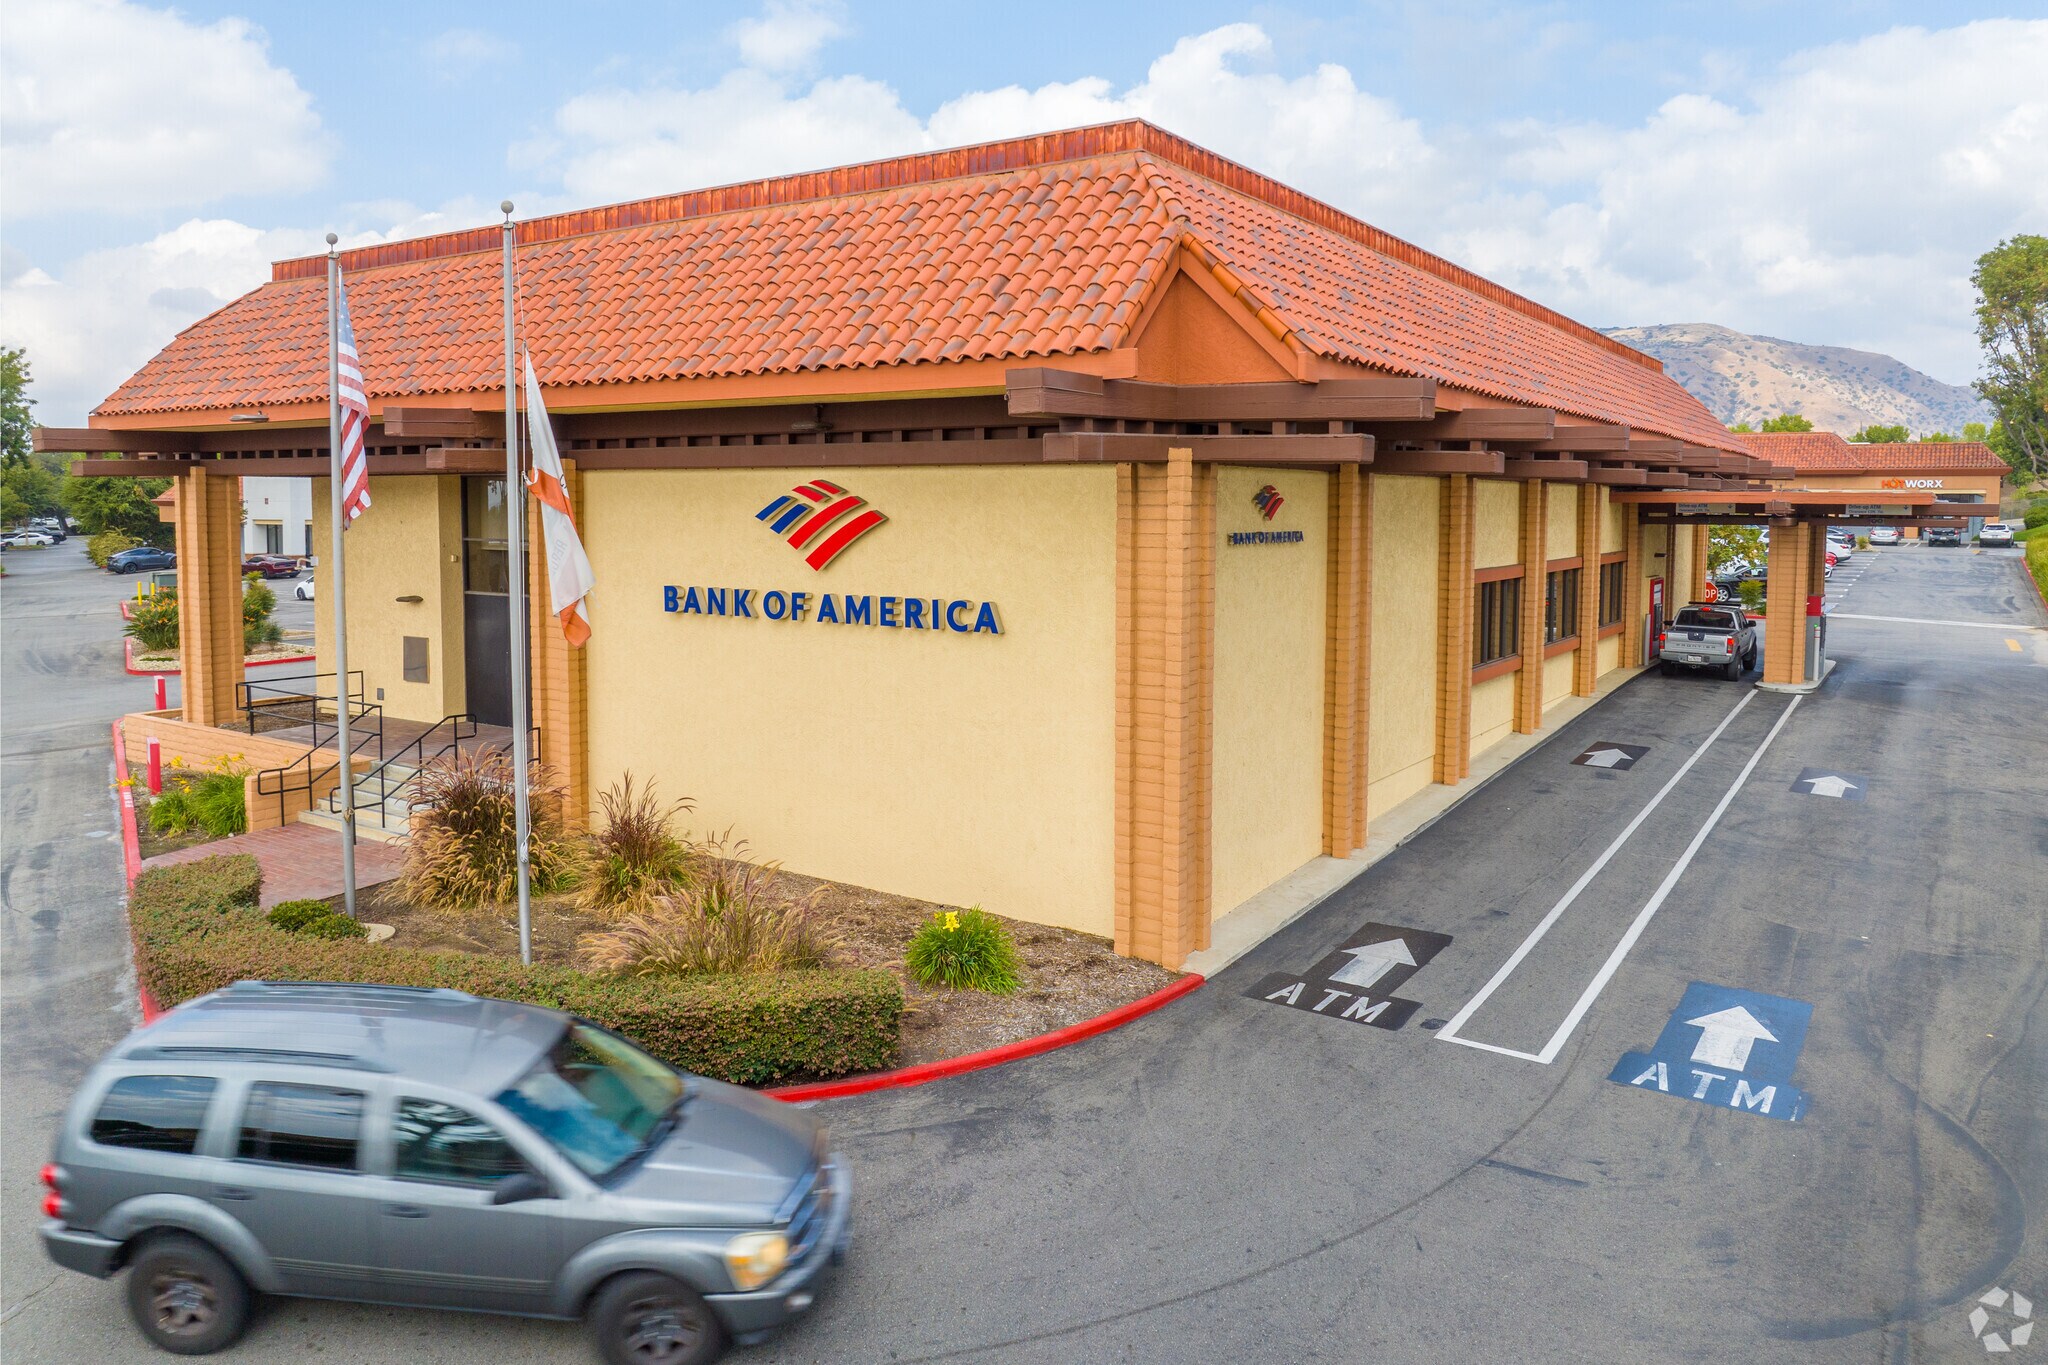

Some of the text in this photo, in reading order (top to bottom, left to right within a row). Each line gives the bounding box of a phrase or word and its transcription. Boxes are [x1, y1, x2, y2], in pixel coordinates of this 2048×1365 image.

[1881, 477, 1943, 489] HOTWORX
[1230, 531, 1304, 545] BANK OF AMERICA
[1705, 589, 1717, 599] OP
[663, 585, 1005, 635] BANK OF AMERICA
[1265, 982, 1392, 1023] ATM
[1631, 1061, 1777, 1114] ATM
